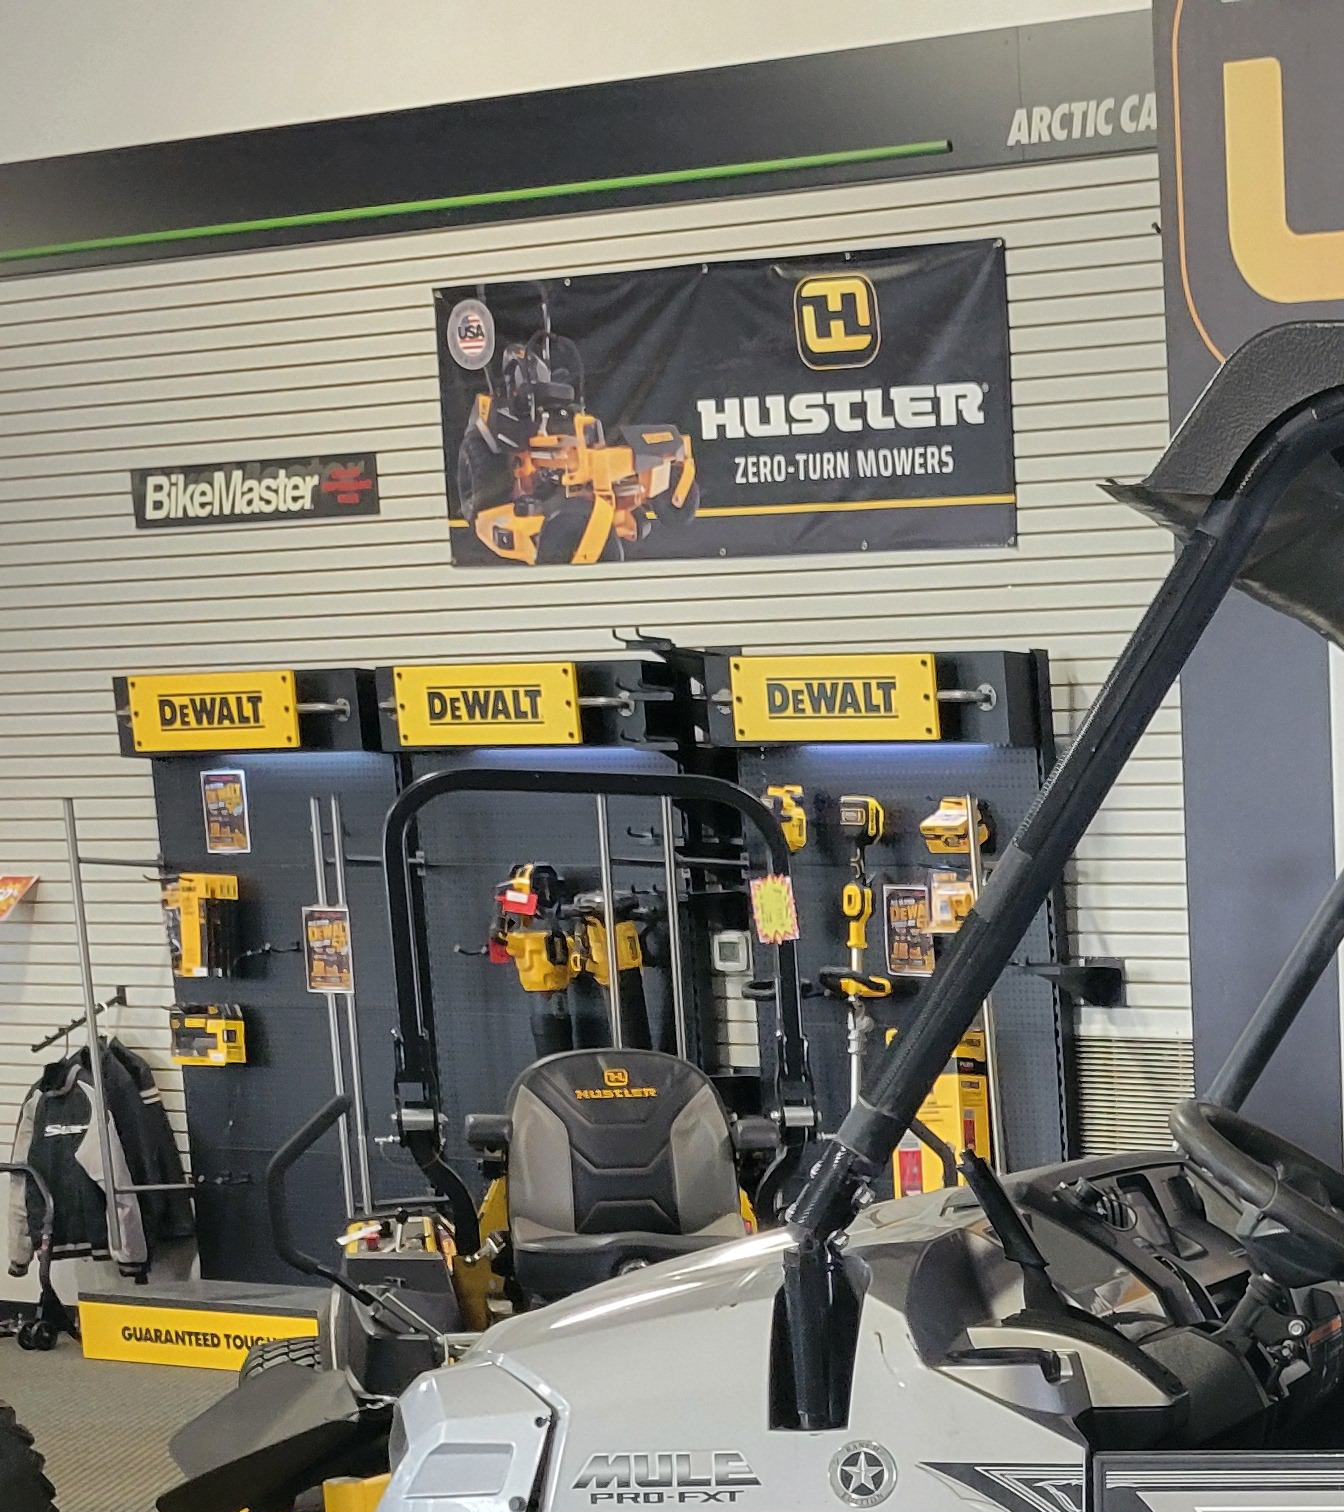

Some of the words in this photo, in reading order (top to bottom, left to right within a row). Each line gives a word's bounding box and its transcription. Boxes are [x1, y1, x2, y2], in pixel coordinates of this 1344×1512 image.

[1006, 98, 1115, 147] ARCTIC
[457, 324, 485, 339] USA
[696, 381, 986, 440] HUSTLER
[734, 451, 851, 484] ZERO-TURN
[856, 444, 955, 478] MOWERS
[144, 468, 320, 520] BikeMaster
[121, 1326, 221, 1349] GUARANTEED
[571, 1452, 763, 1489] MULE
[590, 1490, 745, 1504] PRO-FXT
